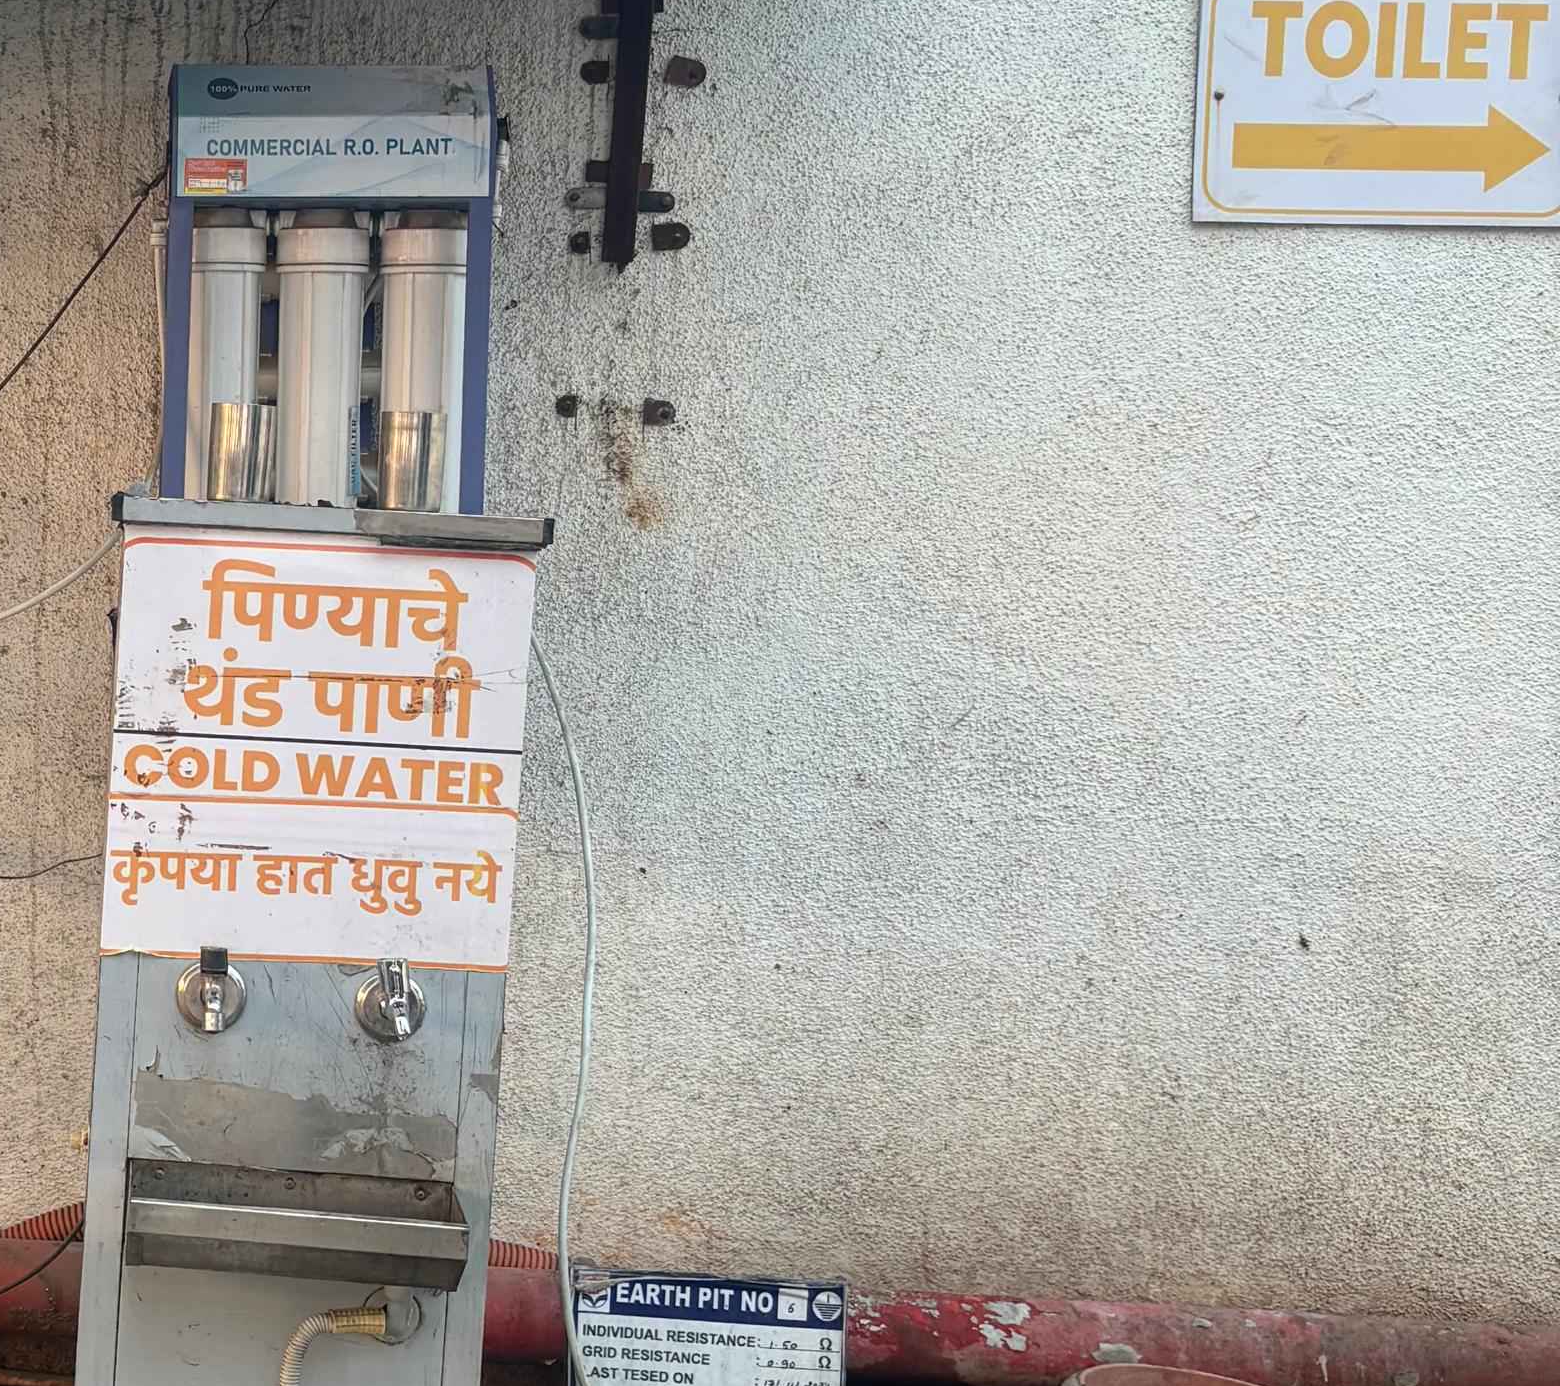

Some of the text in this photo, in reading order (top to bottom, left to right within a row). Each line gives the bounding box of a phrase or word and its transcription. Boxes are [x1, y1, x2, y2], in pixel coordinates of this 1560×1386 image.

[1252, 0, 1549, 80] TOILET
[271, 84, 312, 93] WATER
[206, 138, 452, 156] COMMERCIAL R.O. PLANT
[202, 558, 469, 651] पिण्याचे
[184, 647, 481, 739] थंड पाणी
[124, 745, 504, 806] COLD WATER
[110, 850, 243, 906] कृपया
[253, 854, 338, 896] हात
[433, 851, 503, 904] नये
[616, 1282, 691, 1308] EARTH
[698, 1287, 735, 1311] PIT
[740, 1290, 774, 1313] NO
[582, 1323, 663, 1342] INDIVIDUAL
[582, 1345, 711, 1365] GRID RESISTANCE
[585, 1366, 694, 1385] AST TESED ON
